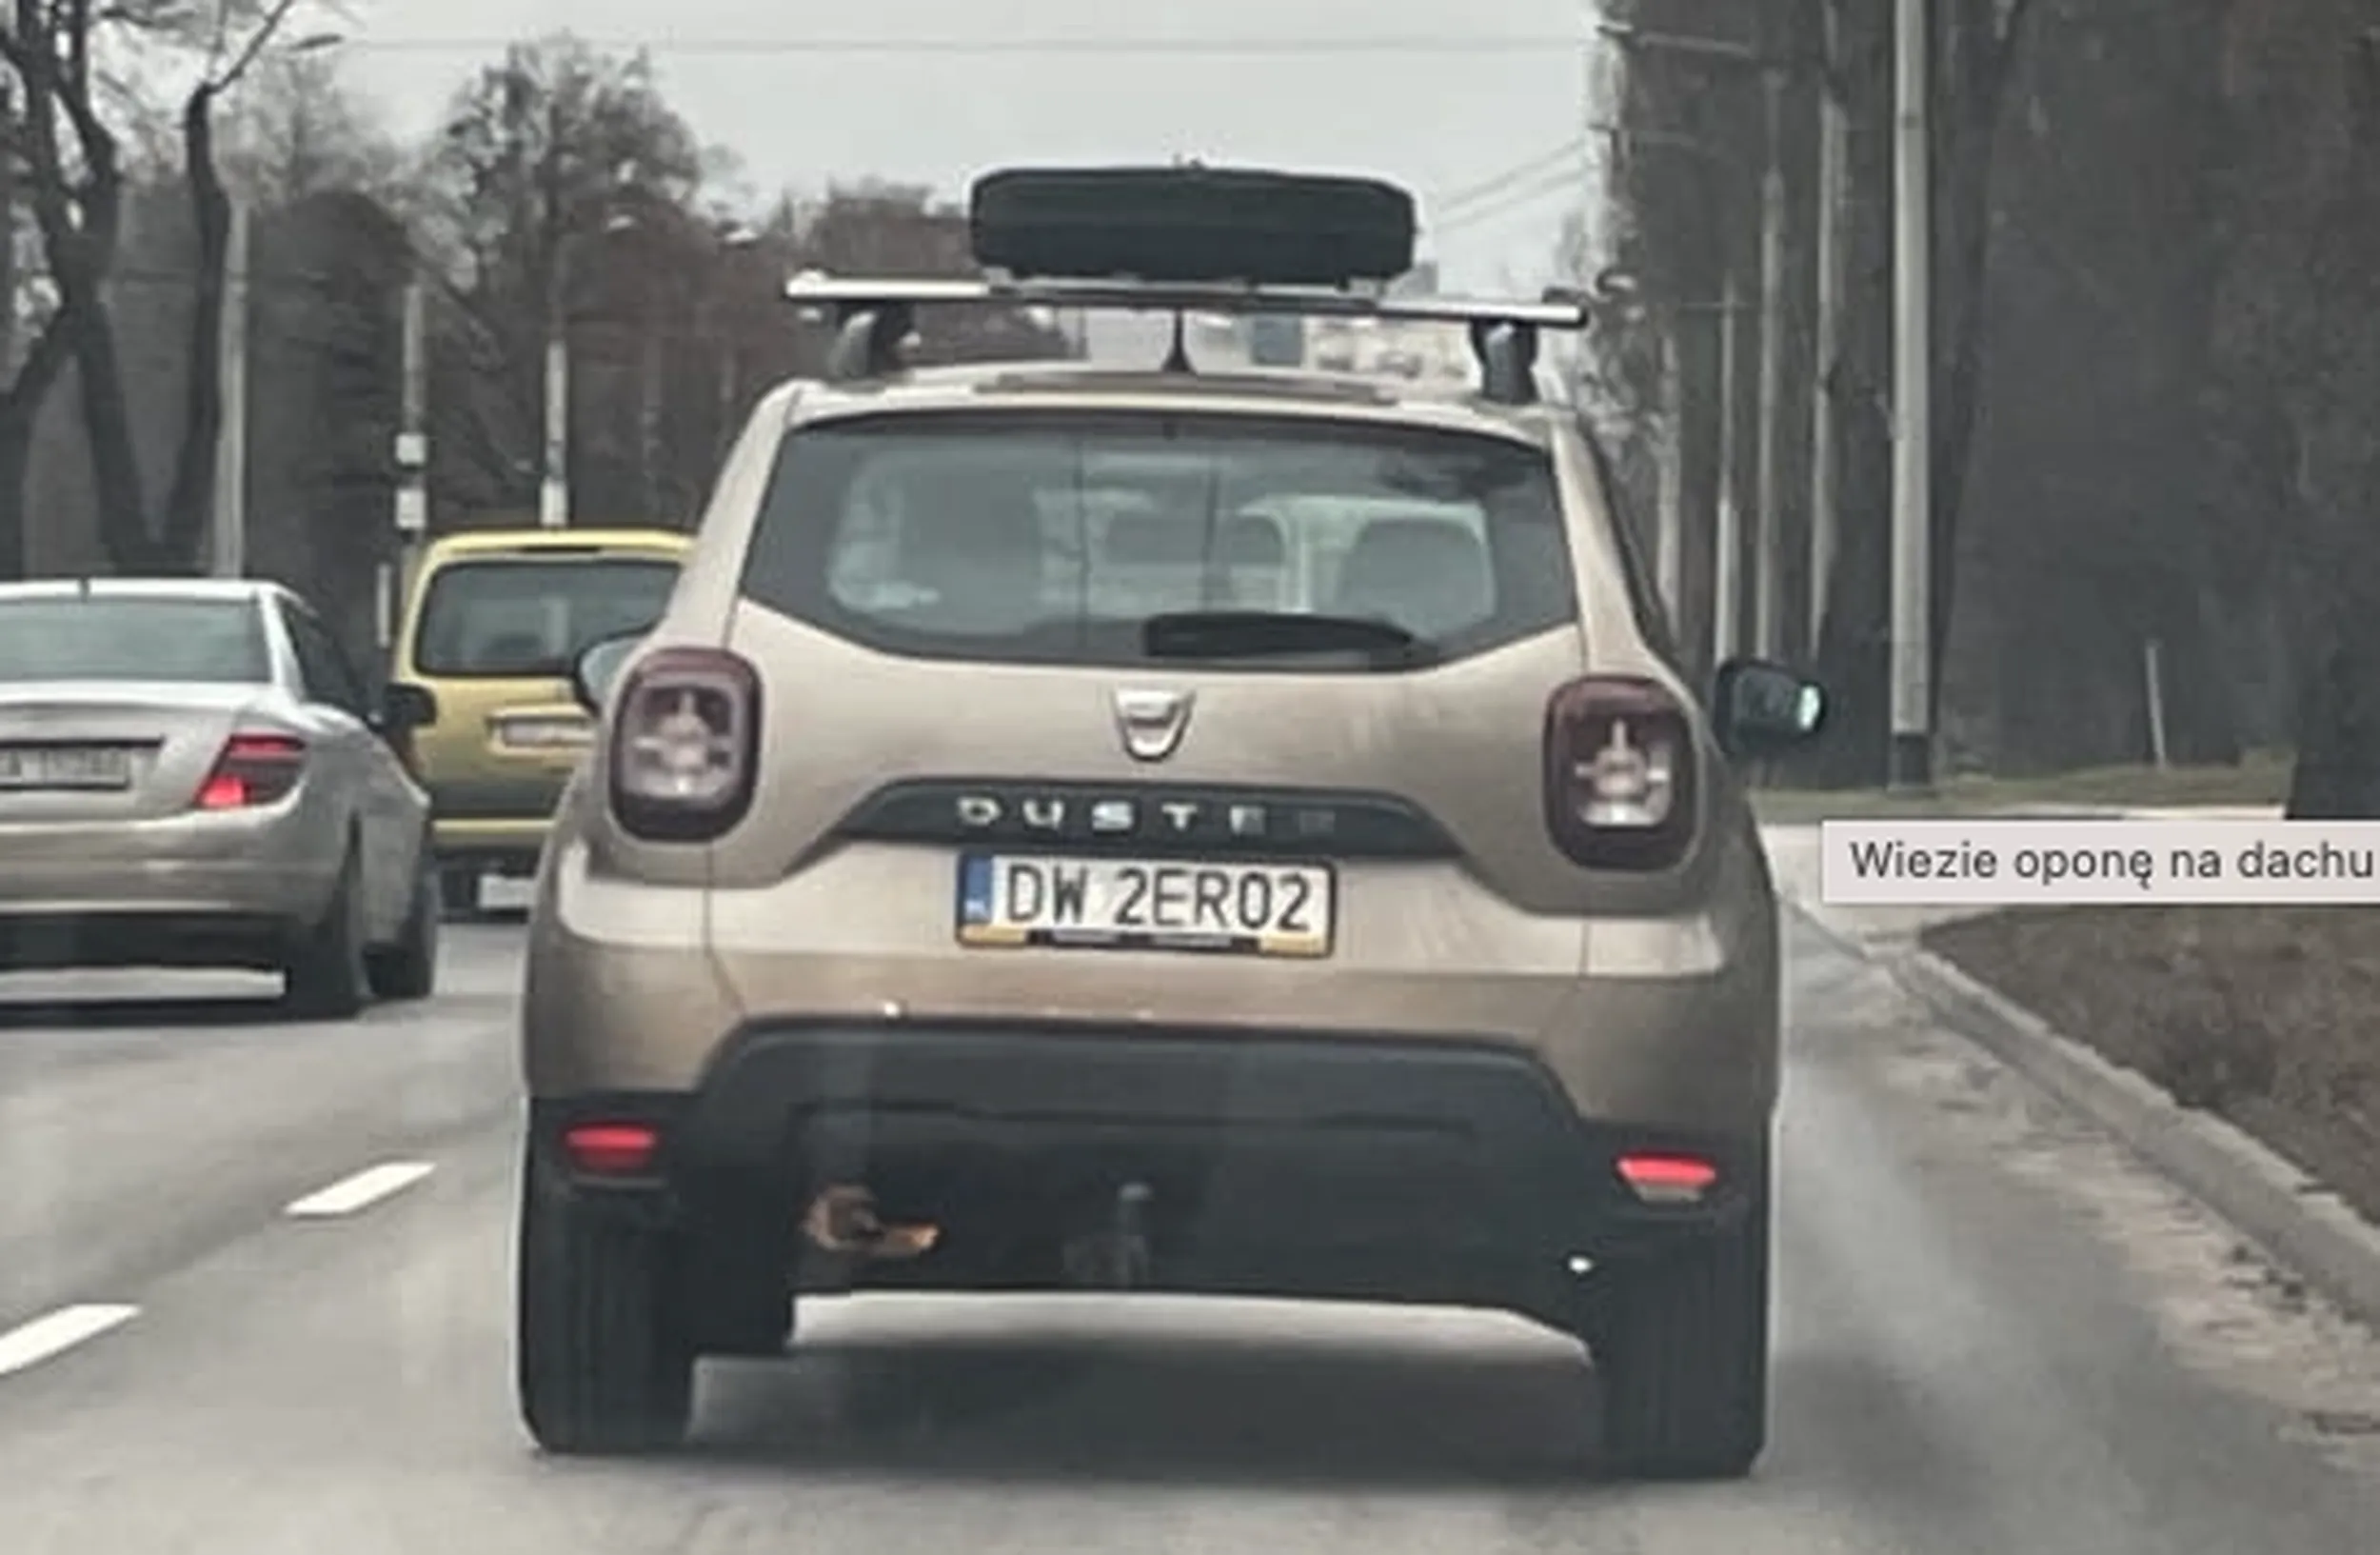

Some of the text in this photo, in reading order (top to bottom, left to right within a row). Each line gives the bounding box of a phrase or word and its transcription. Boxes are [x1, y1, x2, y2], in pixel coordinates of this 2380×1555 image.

[957, 796, 1335, 834] DUSTE
[1008, 862, 1312, 932] DW 2ER02
